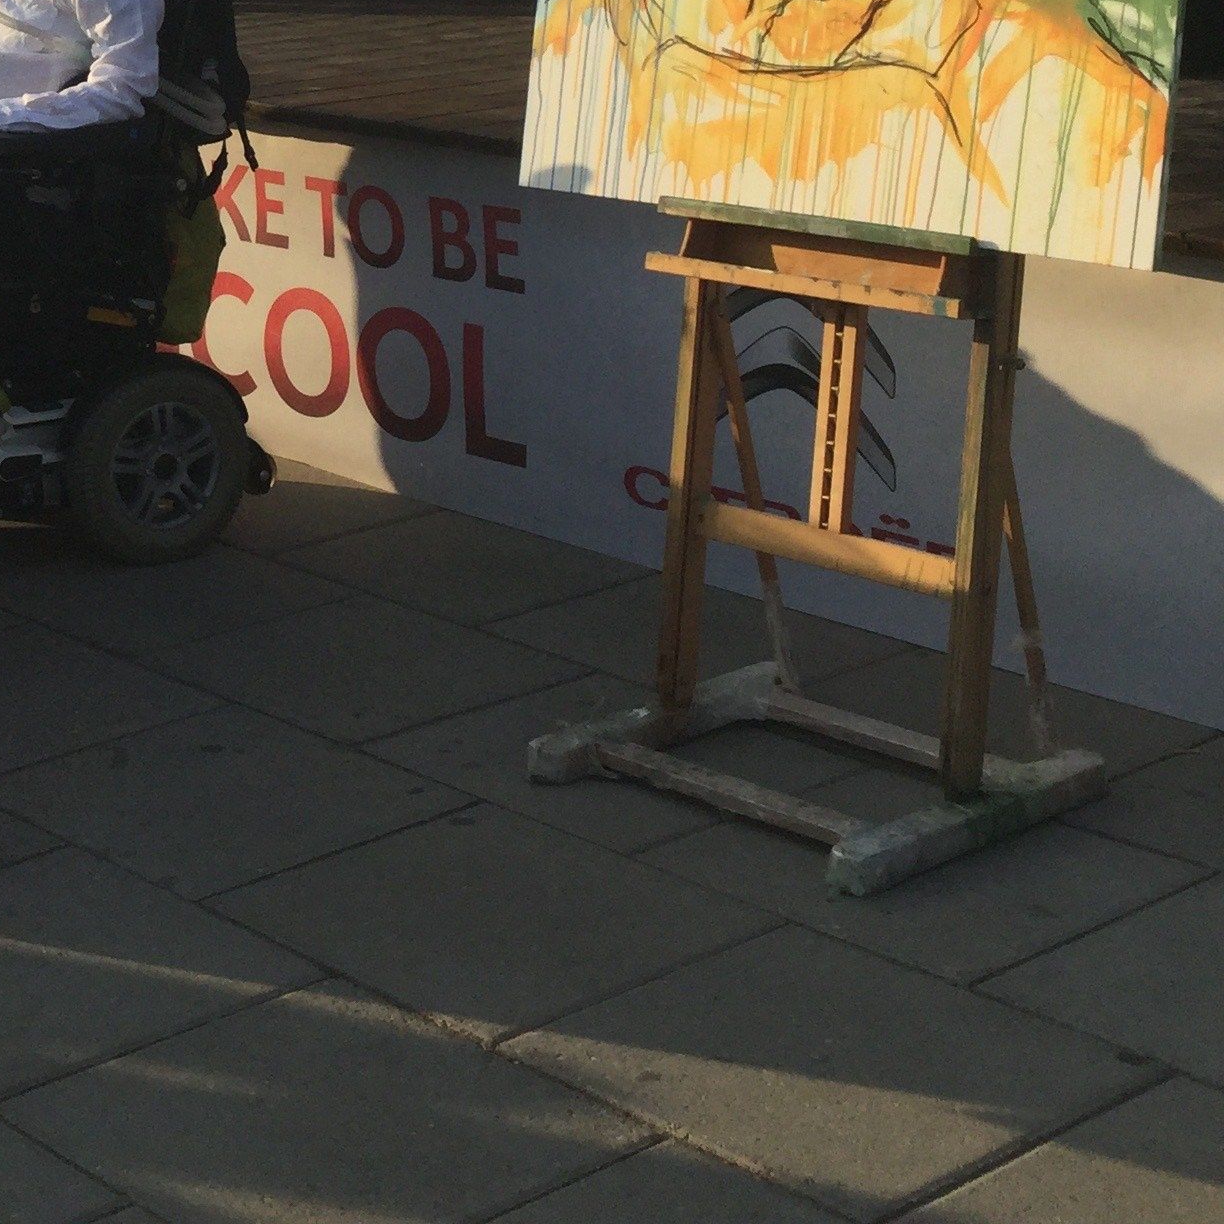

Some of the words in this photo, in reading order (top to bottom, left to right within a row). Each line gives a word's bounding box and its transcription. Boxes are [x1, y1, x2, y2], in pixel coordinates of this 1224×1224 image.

[212, 160, 289, 249] KE
[305, 176, 405, 269] TO
[429, 196, 525, 294] BE
[191, 271, 526, 468] COOL
